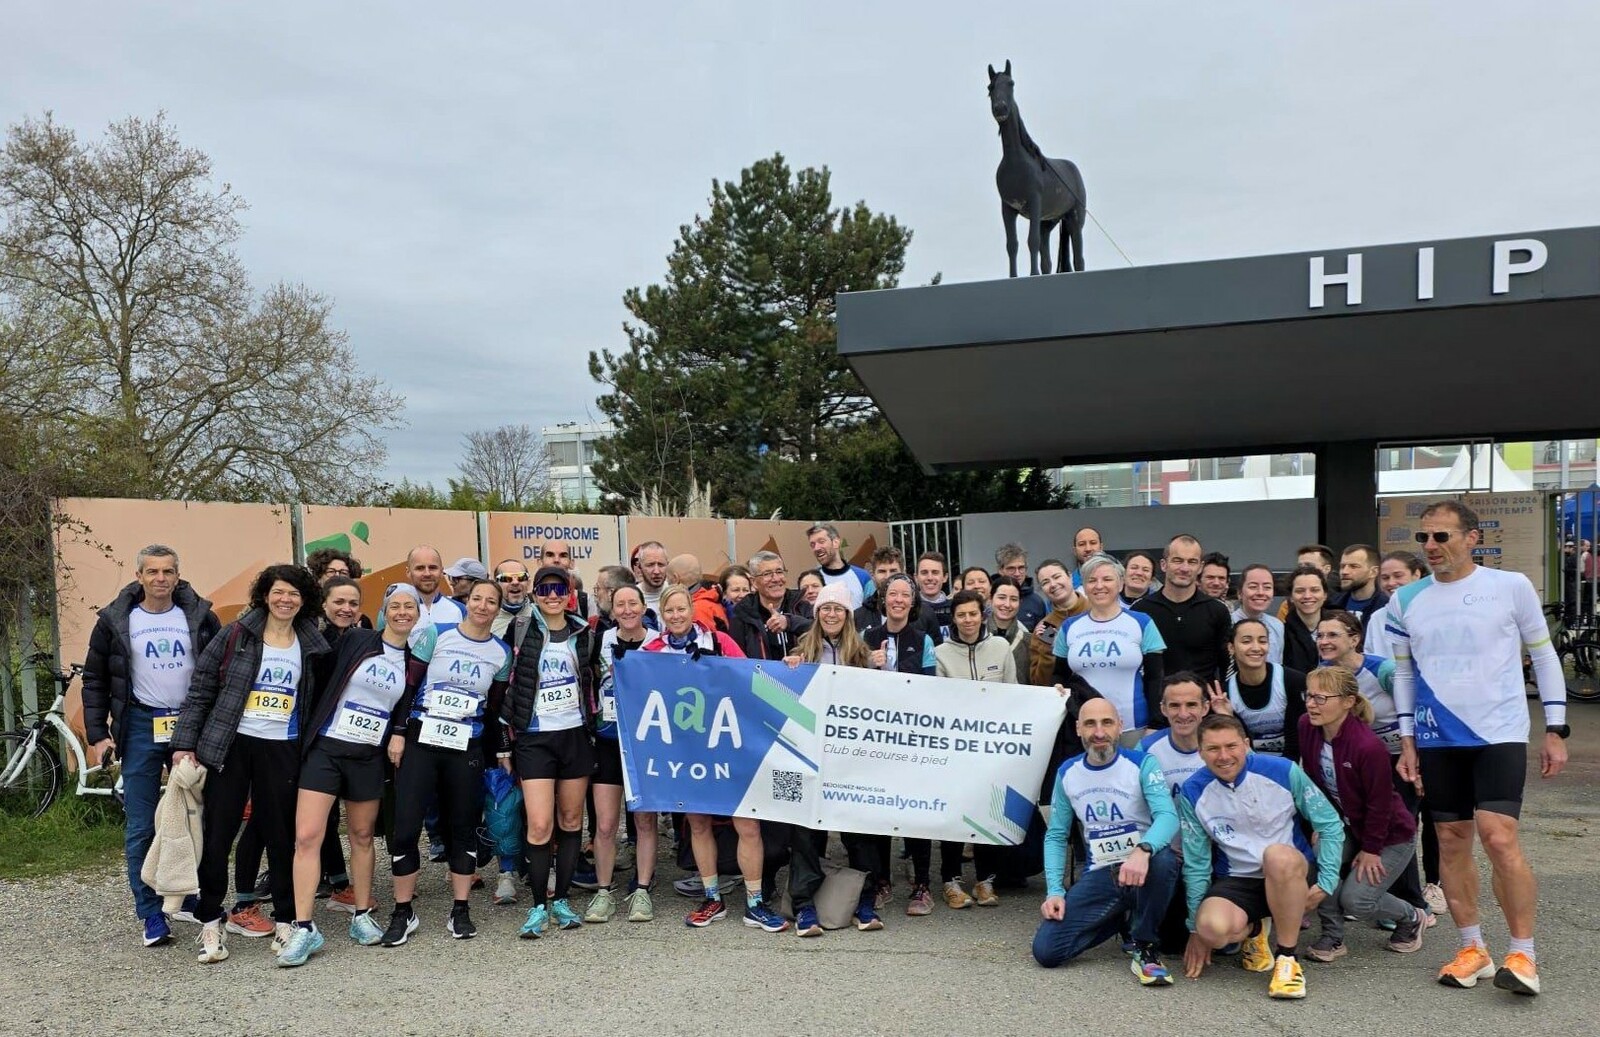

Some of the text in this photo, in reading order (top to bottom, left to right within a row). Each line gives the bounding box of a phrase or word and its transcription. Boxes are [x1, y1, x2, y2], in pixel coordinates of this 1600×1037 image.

[1308, 238, 1548, 309] HIP
[1469, 496, 1538, 506] SAISON 2026
[513, 525, 599, 540] HIPPODROME
[523, 545, 593, 559] DE ILLY
[152, 661, 183, 670] LYON
[365, 677, 391, 691] LYON
[450, 676, 476, 686] LYON
[254, 695, 289, 710] 182.6
[437, 694, 470, 709] 182.1
[540, 688, 573, 703] 182.3
[348, 714, 381, 732] 182.2
[635, 686, 742, 749] AaA
[826, 704, 1033, 736] ASSOCIATION AMICALE
[435, 723, 458, 737] 182
[825, 724, 1031, 756] DES ATHLÈTES DE LYON
[823, 743, 949, 766] Club de course à pied
[646, 758, 730, 780] LYON
[822, 789, 948, 812] www.aaalyon.fr
[1098, 837, 1135, 854] 131.4
